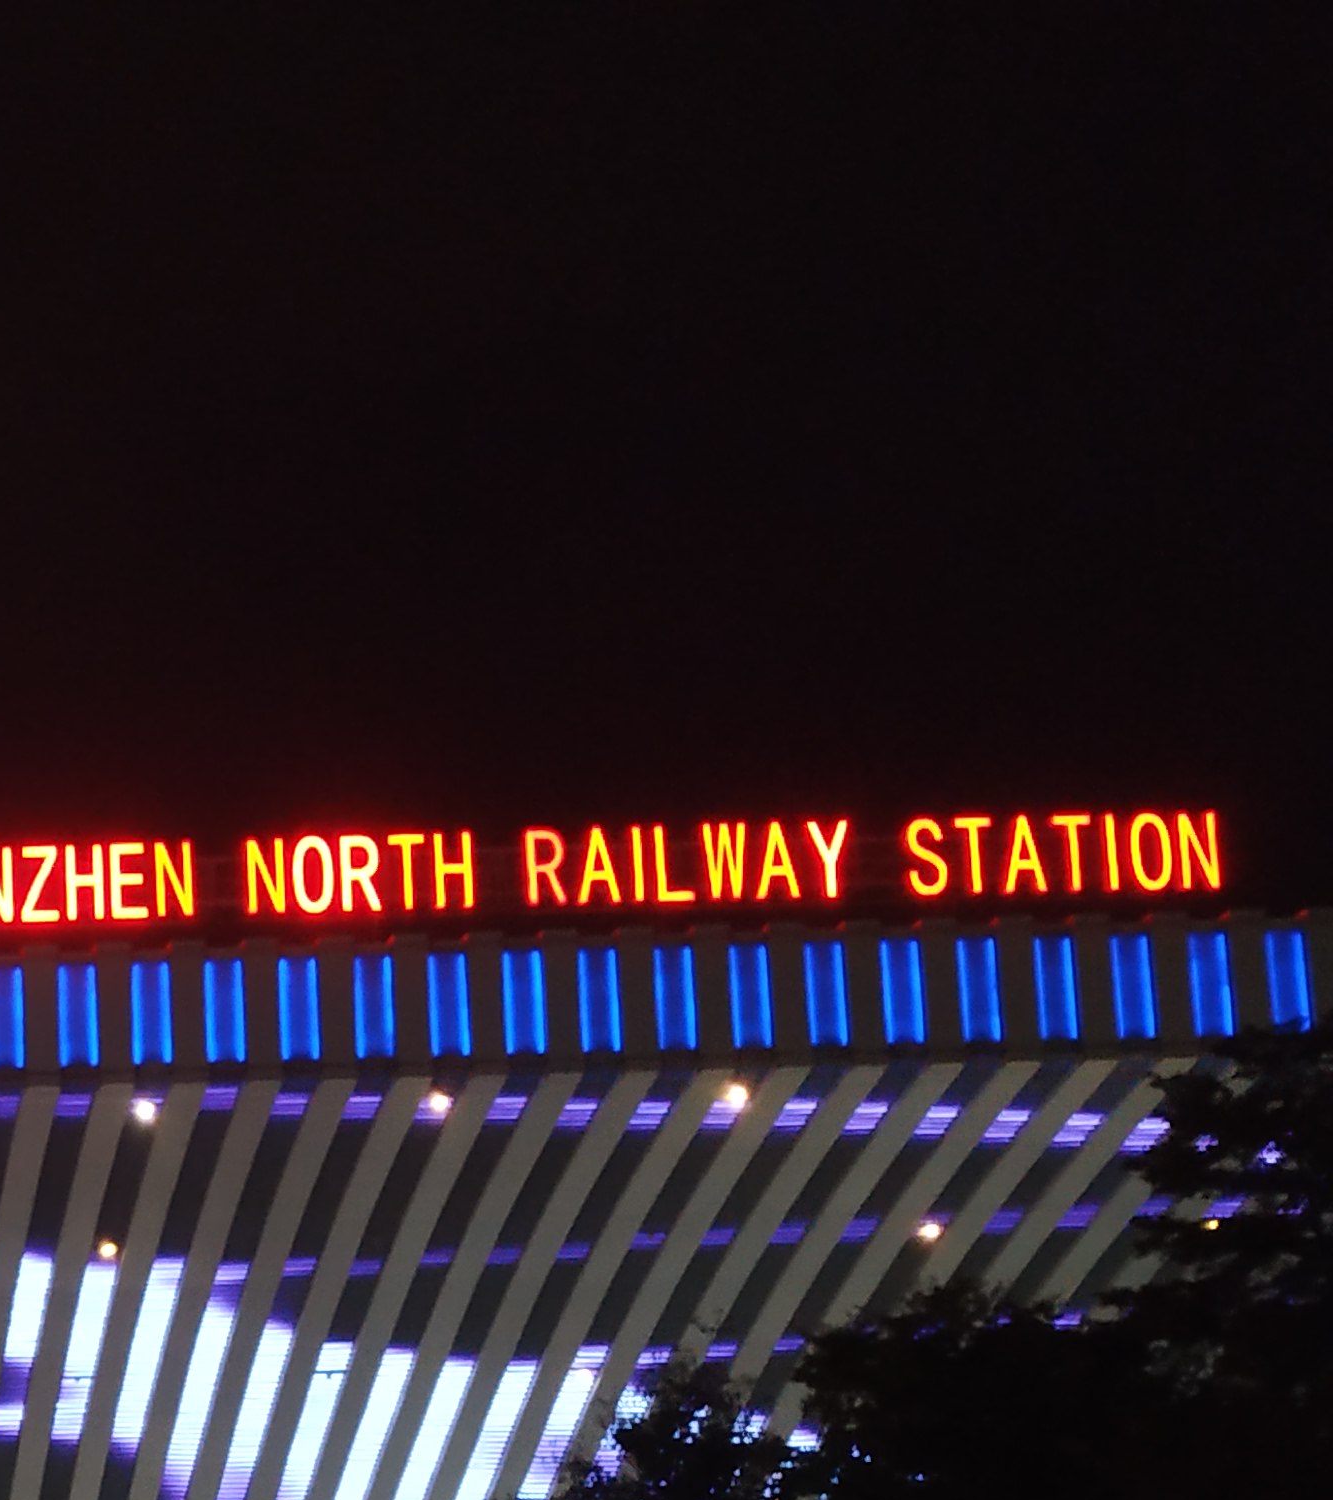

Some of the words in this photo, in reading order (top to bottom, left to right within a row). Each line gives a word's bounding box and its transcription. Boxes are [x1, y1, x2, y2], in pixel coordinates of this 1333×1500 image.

[244, 829, 476, 914] NORTH
[523, 817, 849, 904] RAILWAY
[904, 810, 1222, 897] STATION
